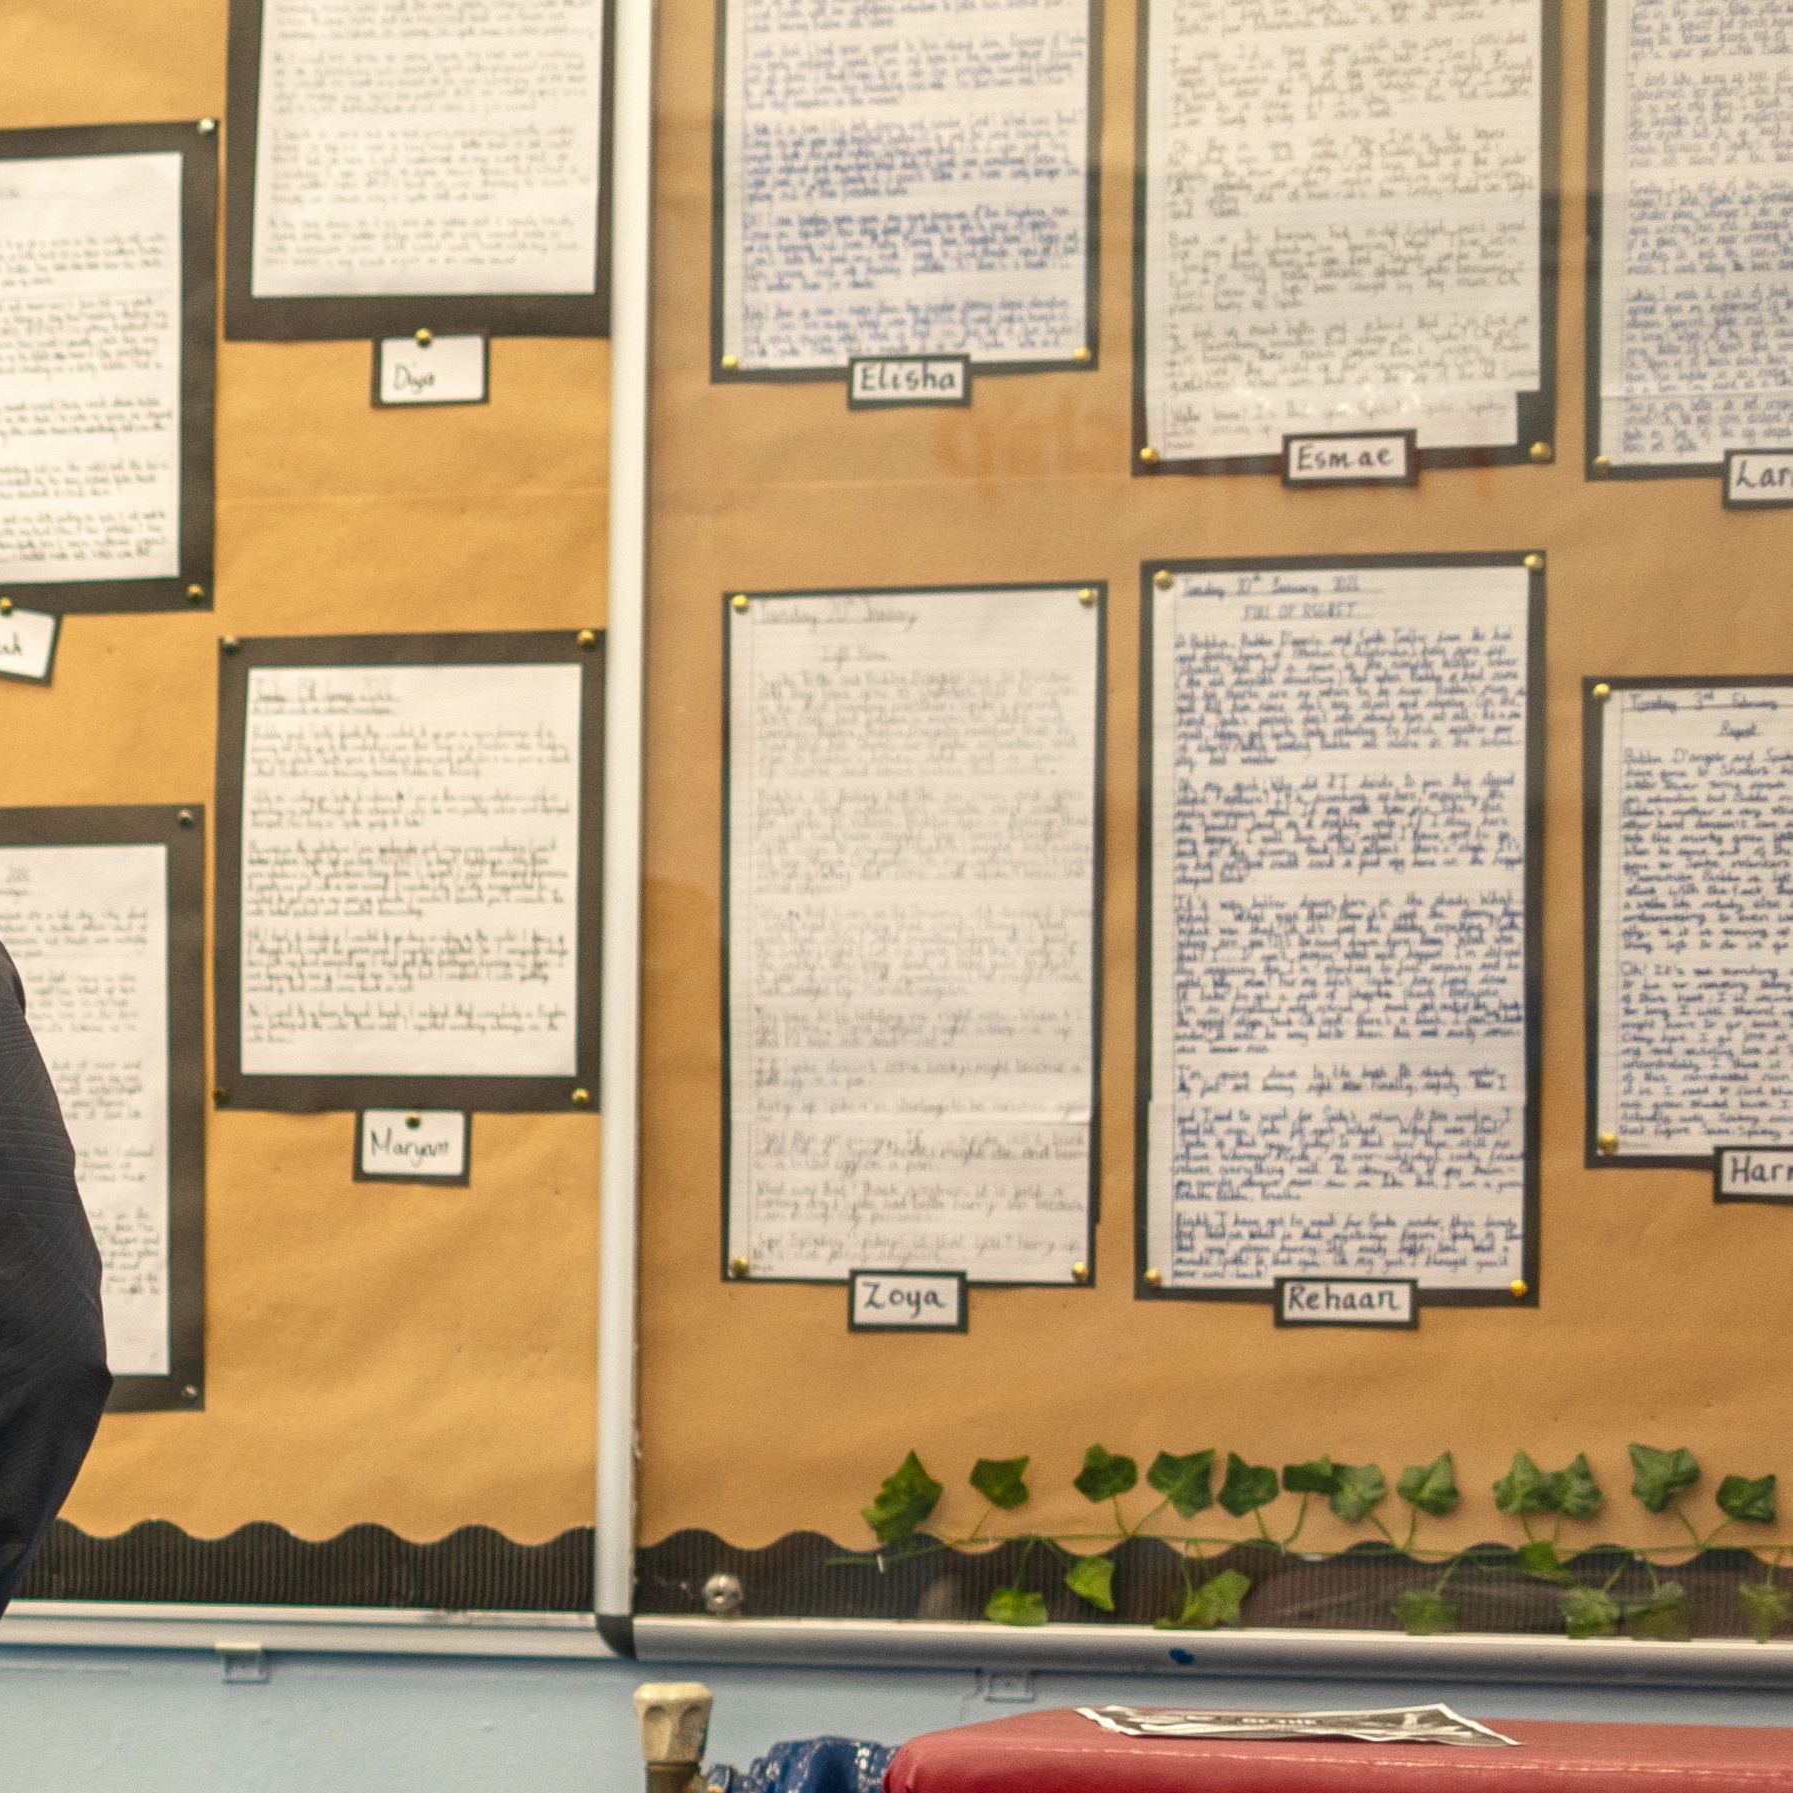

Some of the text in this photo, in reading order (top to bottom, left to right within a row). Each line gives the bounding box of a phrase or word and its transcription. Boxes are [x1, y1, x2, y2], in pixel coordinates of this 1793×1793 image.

[861, 364, 956, 392] Elisha
[1296, 445, 1394, 470] Esmae
[1736, 460, 1793, 488] Lar
[862, 1282, 947, 1319] Zoya
[1288, 1284, 1401, 1311] Rehaan
